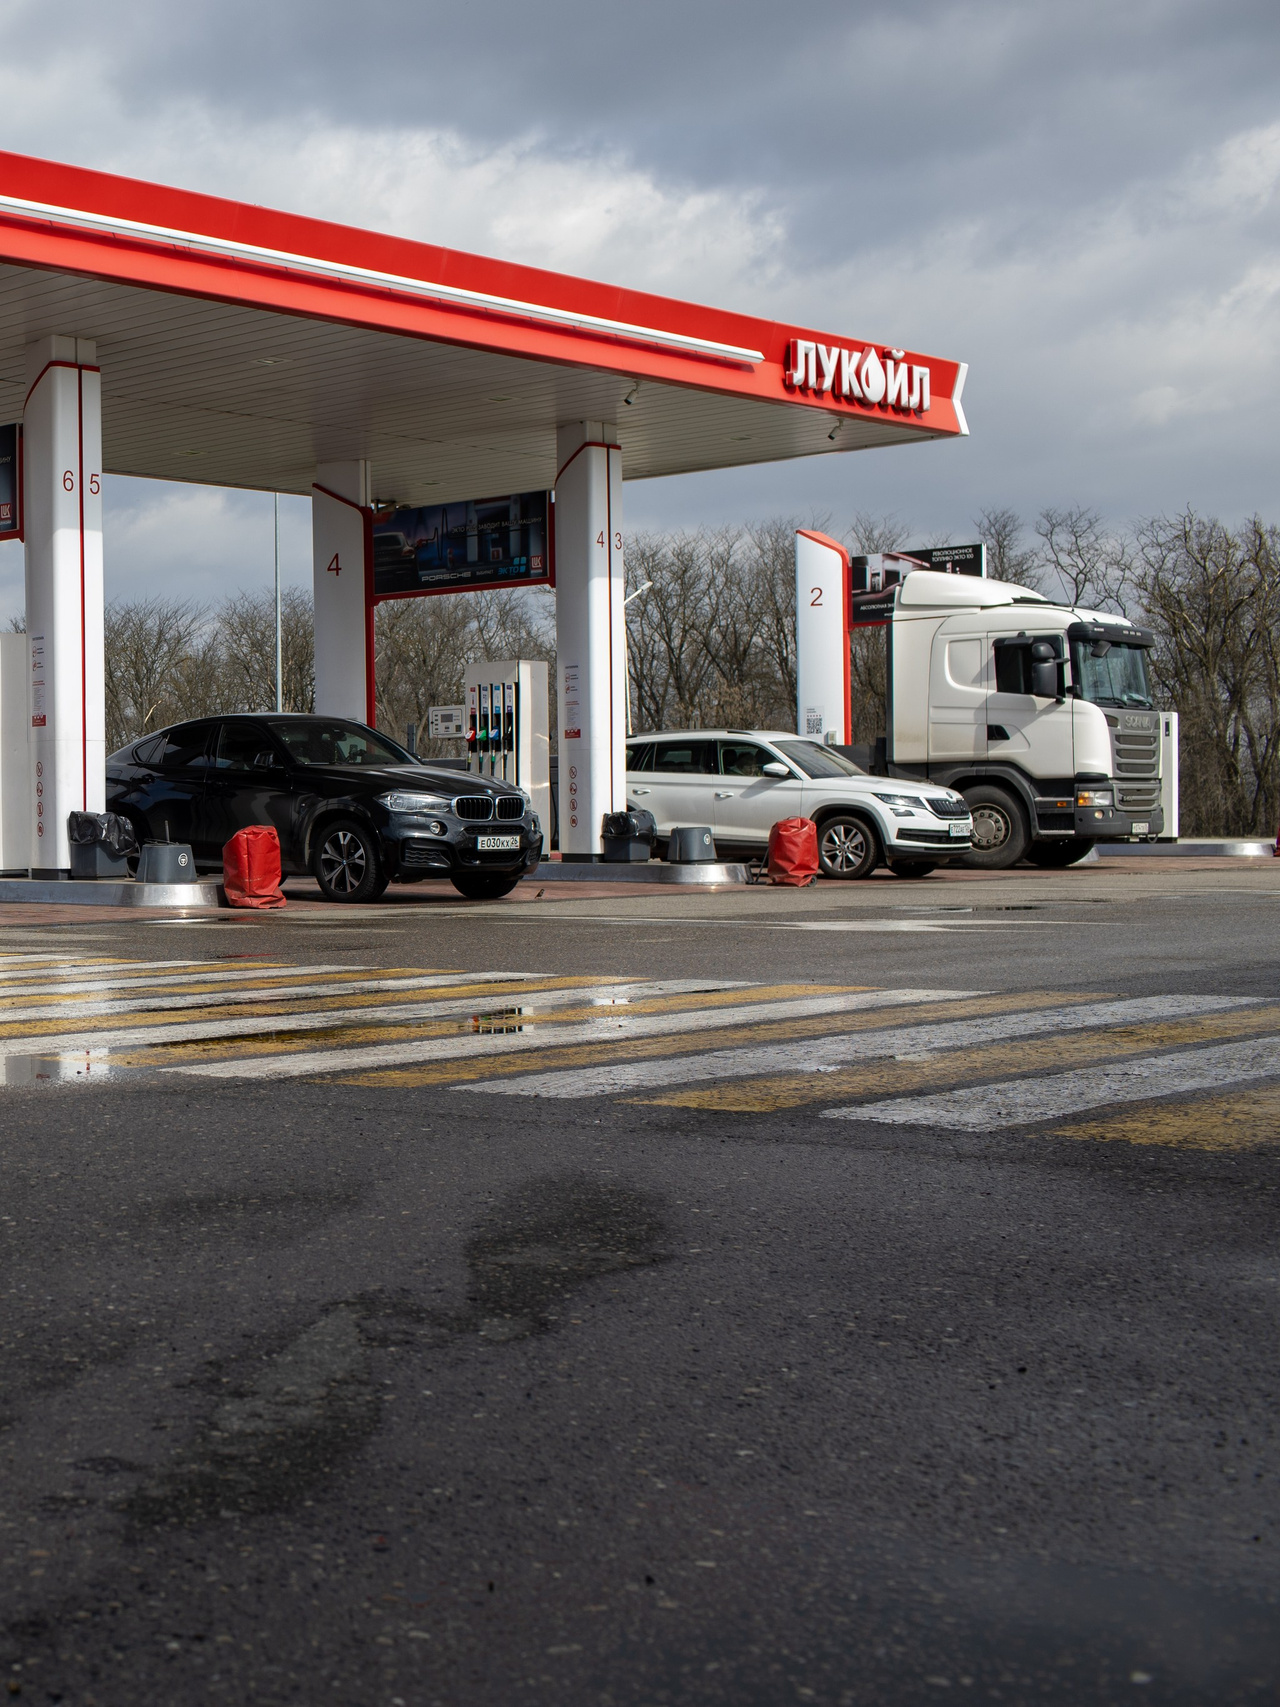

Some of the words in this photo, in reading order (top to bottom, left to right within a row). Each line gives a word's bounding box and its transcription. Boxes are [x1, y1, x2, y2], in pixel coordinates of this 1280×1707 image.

[787, 339, 930, 411] ЛУКОЙЛ
[63, 470, 74, 491] 6
[90, 473, 100, 494] 5
[597, 531, 605, 548] 4
[615, 532, 622, 550] 3
[327, 553, 341, 576] 4
[422, 571, 471, 581] PORSCHE
[498, 566, 519, 575] ЭКТО
[810, 587, 823, 606] 2
